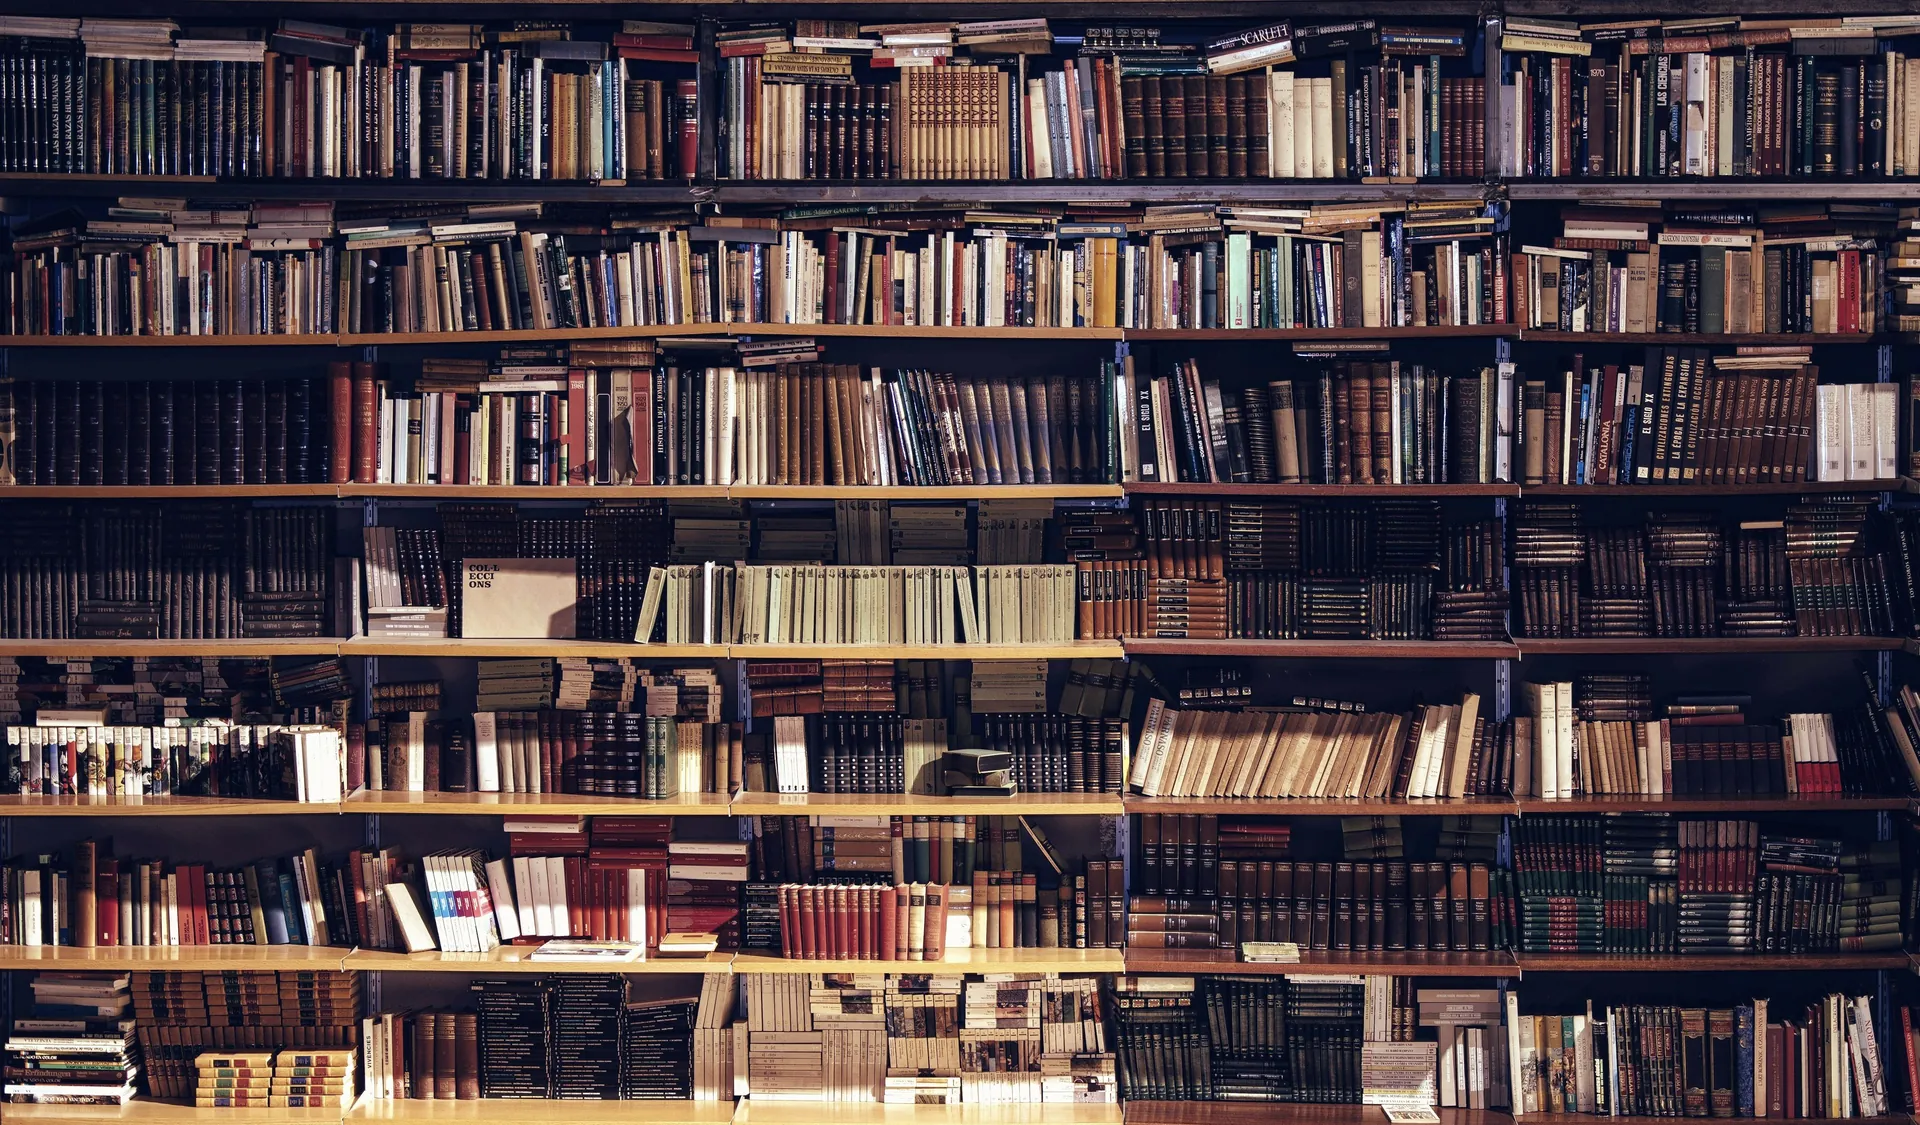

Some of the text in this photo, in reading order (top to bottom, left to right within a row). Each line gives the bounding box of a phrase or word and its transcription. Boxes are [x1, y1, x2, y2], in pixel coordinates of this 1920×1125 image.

[1240, 24, 1289, 47] SCARLETT
[1590, 68, 1605, 77] 1970
[1657, 56, 1668, 106] LAS CIENCIAS
[52, 74, 60, 155] LAS RAZAS HUMANAS
[918, 72, 926, 128] BRICOLAJE
[970, 72, 979, 128] BRICOLAJE
[989, 72, 998, 128] BRICOLAJE
[1757, 96, 1763, 105] DE
[1495, 276, 1503, 300] FREDERICK
[1693, 358, 1705, 402] OCCIDENTAL
[1716, 380, 1724, 399] FAUNA
[1750, 379, 1758, 397] FAUNA
[1760, 379, 1769, 396] FAUNA
[1772, 379, 1781, 397] FAUNA
[1784, 378, 1792, 396] FAUNA
[1795, 376, 1803, 395] FAUNA
[1140, 390, 1150, 431] EL SIGLO XX
[1644, 392, 1655, 402] XX
[1656, 356, 1675, 460] CIVILIZACIONES EXTINGUIDAS
[1670, 426, 1684, 447] ÉPOCA
[1677, 359, 1690, 399] EXPANSIÓN
[1643, 407, 1653, 424] SIGLO
[1687, 404, 1700, 448] CIVILIZACIÓN
[1598, 420, 1611, 470] CATALONIA
[1144, 703, 1160, 747] PARNASO
[1156, 716, 1172, 756] PARNASO
[24, 1069, 70, 1079] Erfindungen
